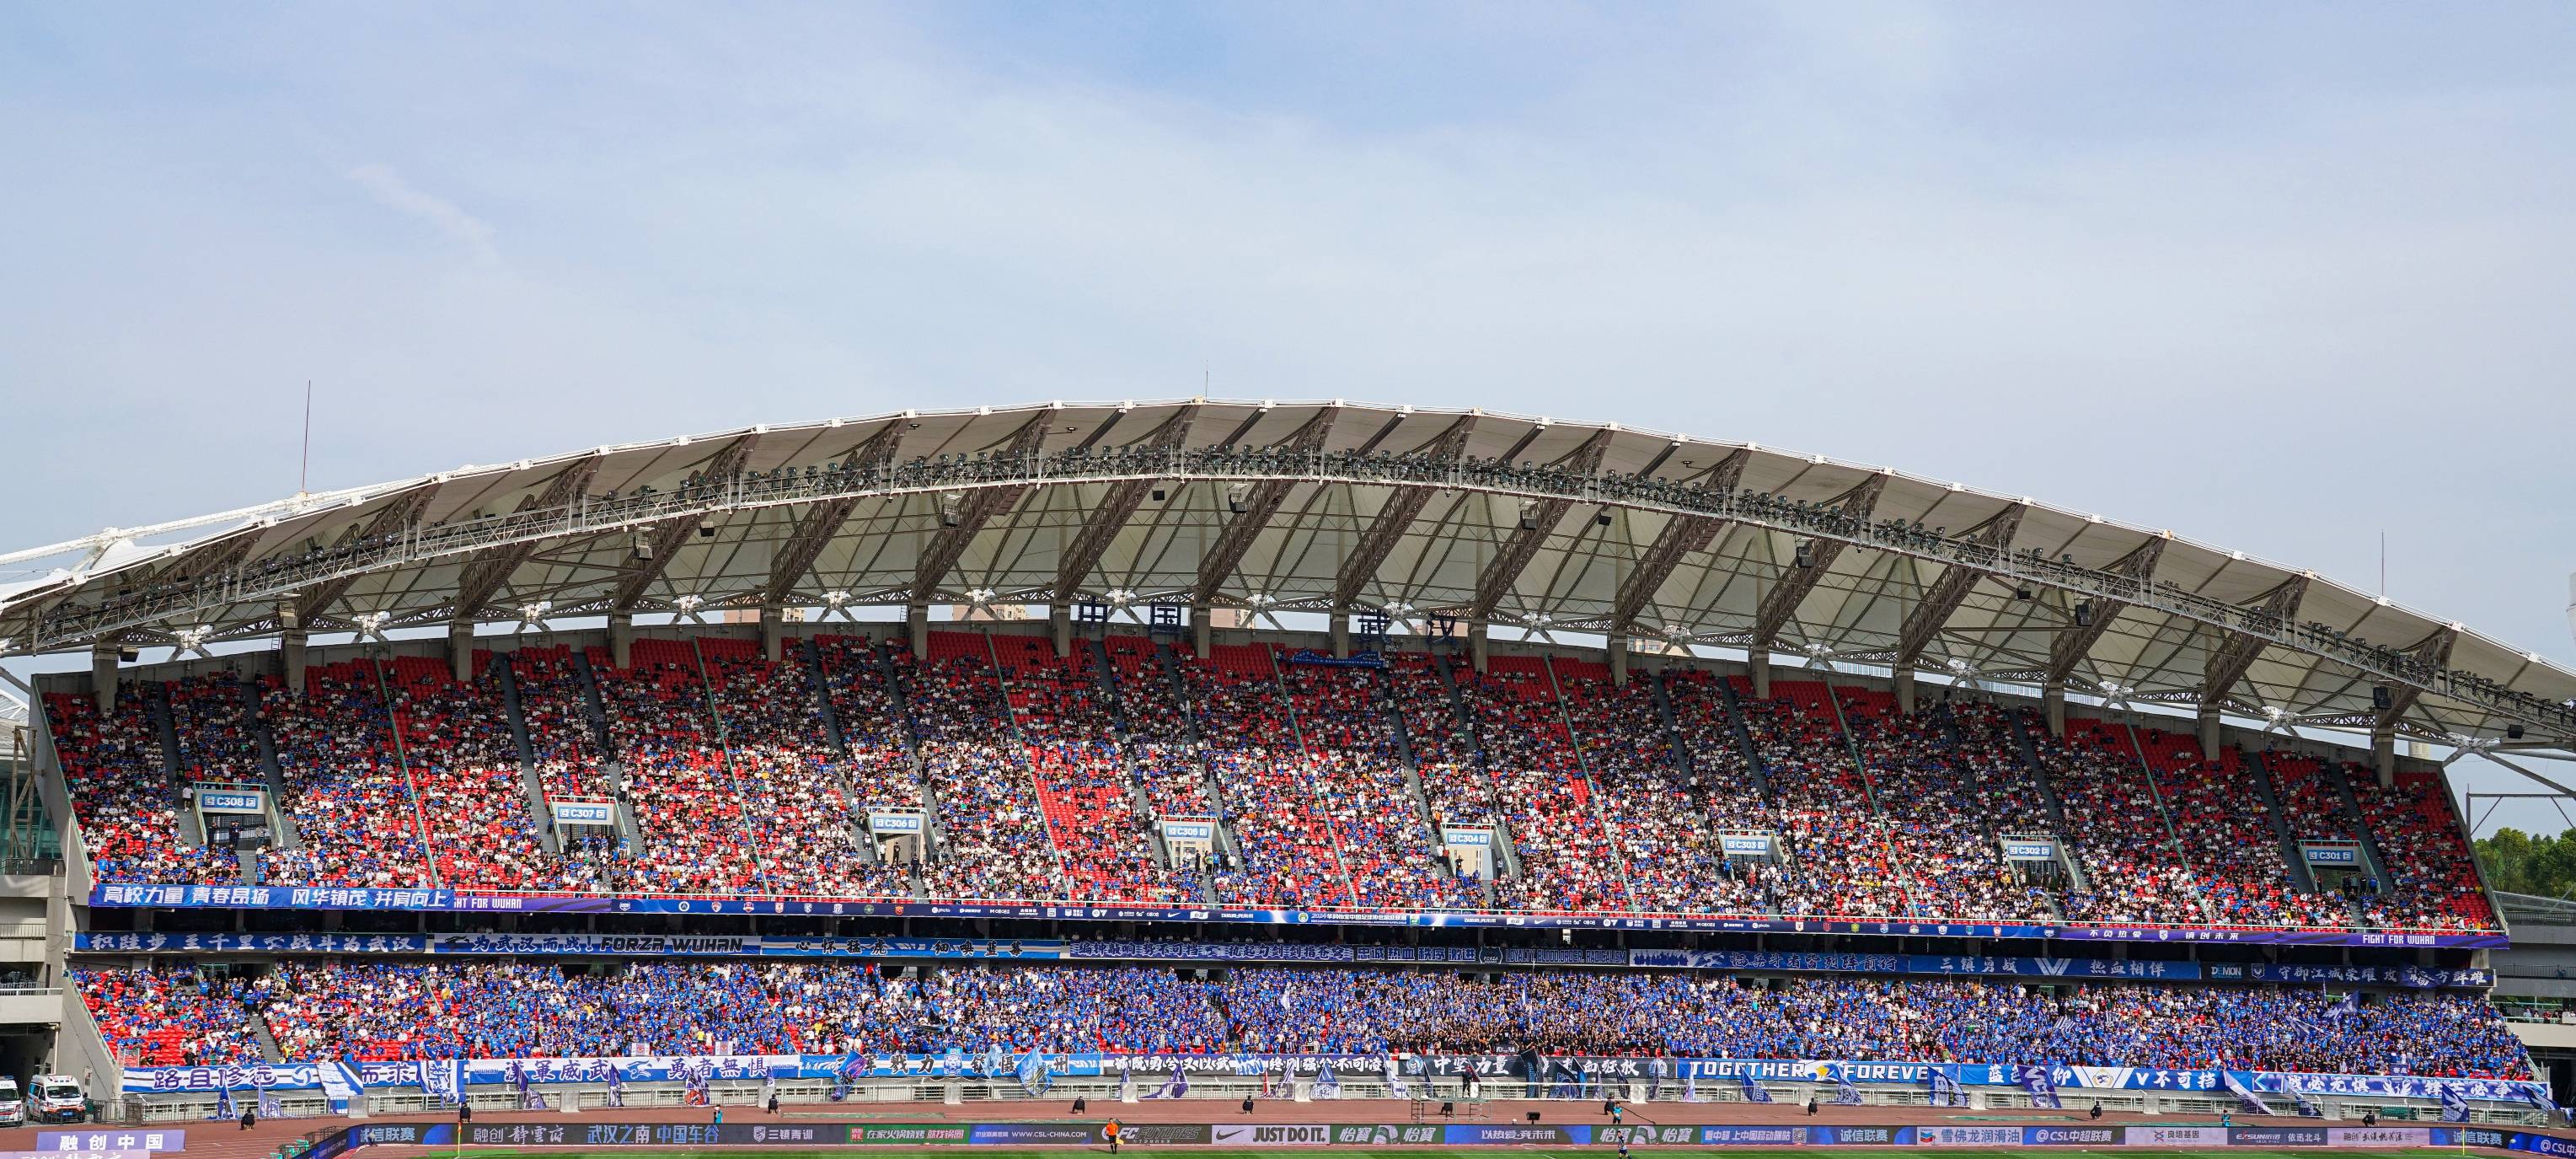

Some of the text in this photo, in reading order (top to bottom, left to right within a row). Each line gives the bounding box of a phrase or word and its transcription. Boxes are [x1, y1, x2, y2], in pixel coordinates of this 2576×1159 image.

[1079, 596, 1459, 646] 中国 武汉
[217, 797, 244, 807] C308
[570, 808, 595, 818] C307
[885, 819, 908, 828] C306
[1177, 828, 1198, 836] C305
[1458, 834, 1479, 843] C304
[1736, 840, 1757, 849] C303
[2018, 846, 2040, 855] C302
[104, 887, 447, 907] 高校力量 青春昂扬 风华镇茂 并肩向上
[454, 898, 522, 909] HT FOR WUHAN
[90, 932, 415, 952] 积跬步 至千里 战斗为武汉
[600, 936, 743, 953] FORZA WUHAN
[795, 938, 888, 956] 心怀猛虎
[2363, 935, 2435, 945] FIGHT FOR WUHAN
[1357, 947, 1476, 961] 忠诚 热血 秩序 激进
[1940, 957, 2166, 978] 三镇勇战 热血相伴
[2211, 966, 2242, 975] DEMON
[1434, 1056, 1509, 1075] 中坚力量
[1690, 1060, 1944, 1082] TOGETHER FOREVE
[155, 1066, 276, 1089] 路且修远
[1989, 1064, 2072, 1087] 蓝色仰
[361, 1129, 415, 1143] 诚信联赛
[474, 1129, 505, 1143] 融创
[586, 1125, 720, 1145] 武汉之南 中国车谷
[768, 1129, 813, 1140] 三镇青训
[867, 1129, 925, 1140] 在家火锅烧烤
[1138, 1127, 1202, 1139] FUTURES
[1253, 1127, 1326, 1142] JUST DO IT.
[1705, 1130, 1730, 1140] 看中超
[1840, 1129, 1888, 1142] 诚信联赛
[1941, 1129, 2020, 1143] 雪佛龙润滑油
[2036, 1129, 2112, 1142] @CSL中超联赛
[2167, 1130, 2199, 1139] 良培基因
[2287, 1133, 2322, 1142] 依迅北斗
[2454, 1130, 2503, 1146] 诚信联赛
[60, 1134, 163, 1151] 融创中国
[2540, 1139, 2576, 1156] @CSL中
